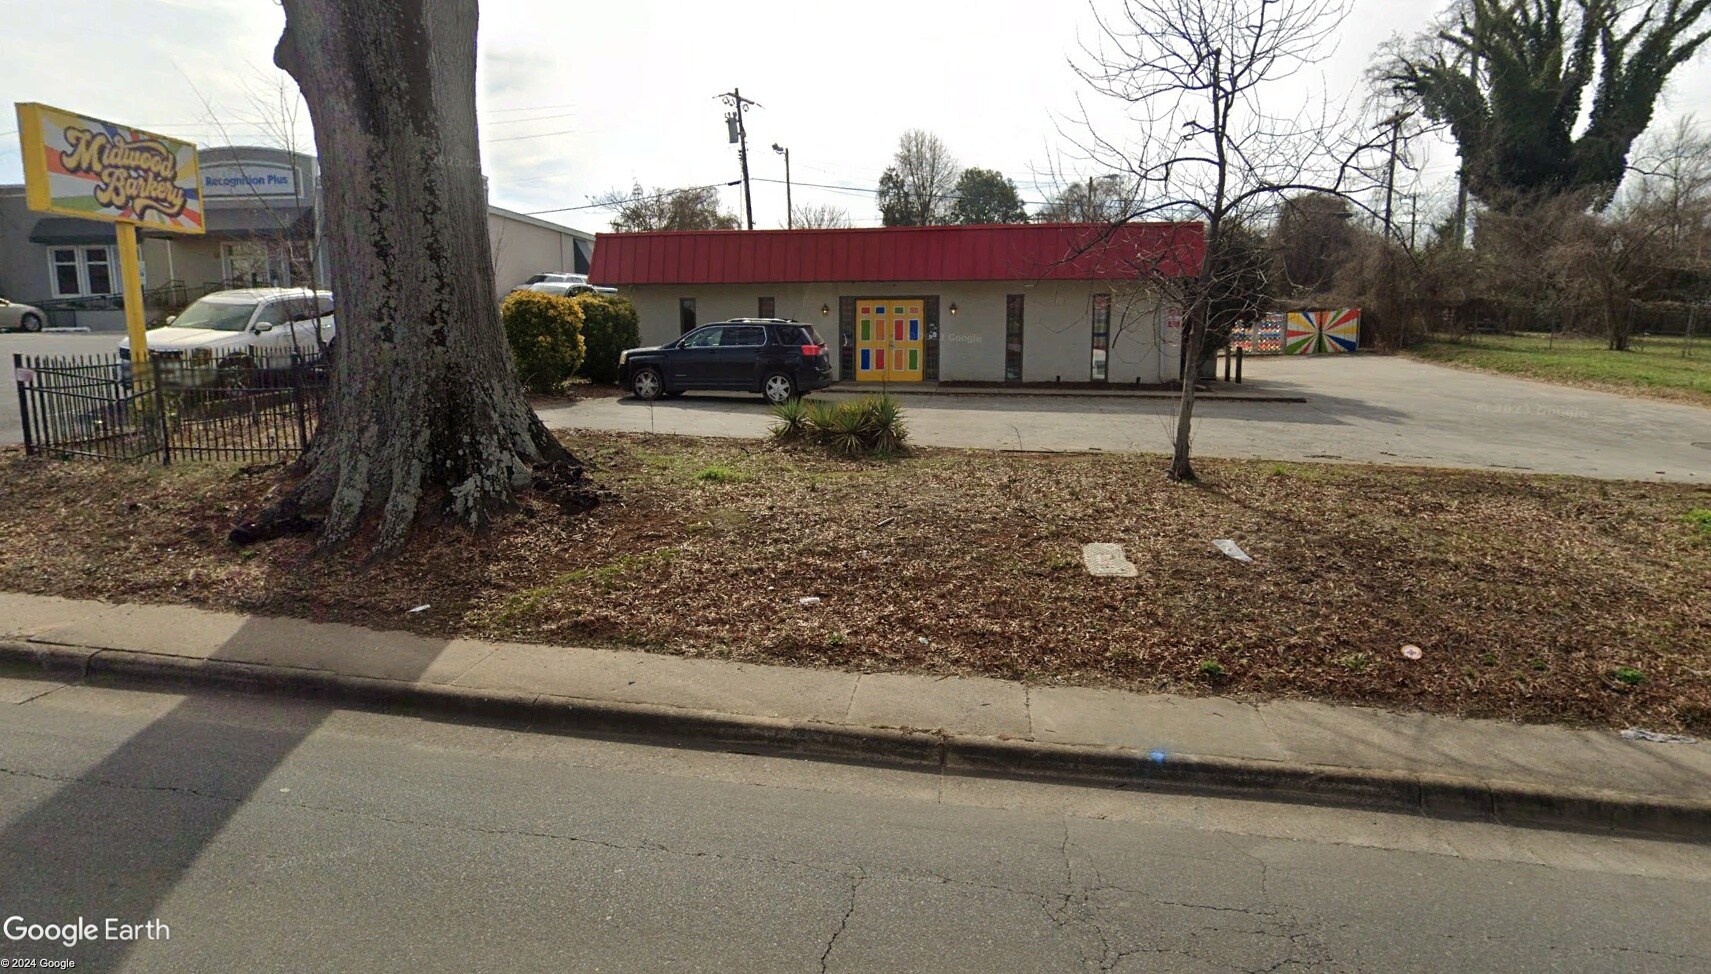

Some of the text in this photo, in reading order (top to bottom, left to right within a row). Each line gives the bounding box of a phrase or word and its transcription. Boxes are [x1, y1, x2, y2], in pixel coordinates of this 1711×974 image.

[60, 125, 178, 181] Midwood
[94, 164, 187, 219] Barkery
[205, 174, 288, 188] Recognition Plus
